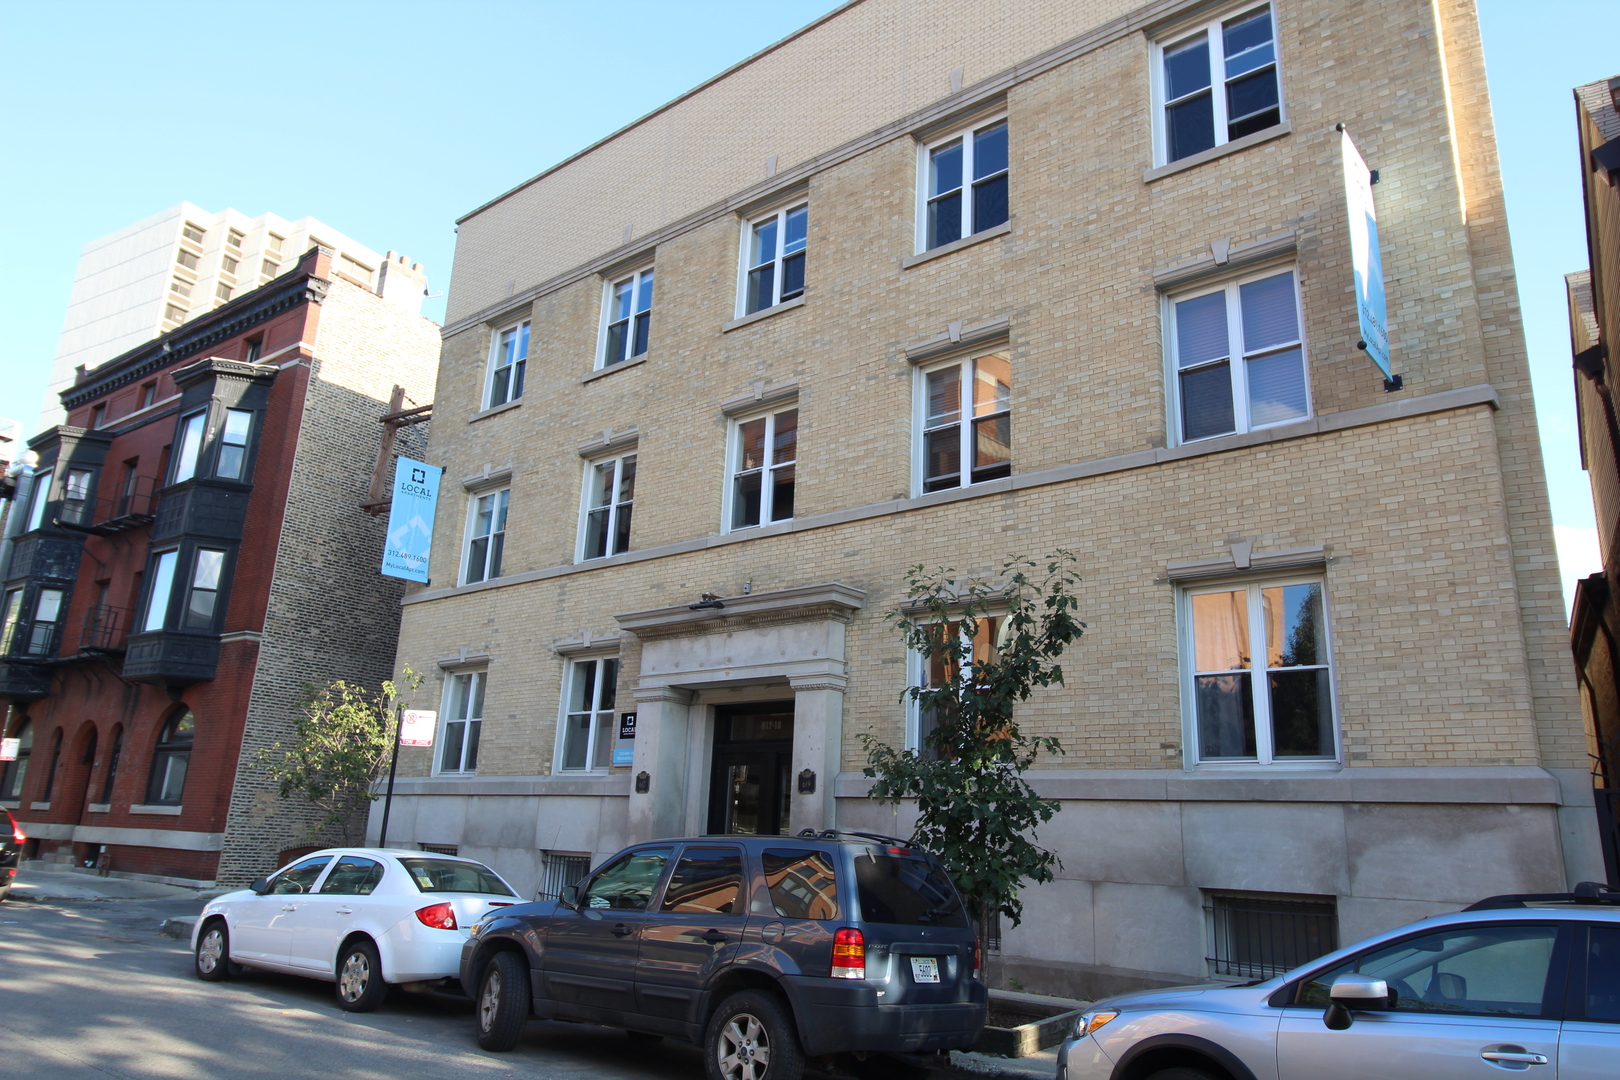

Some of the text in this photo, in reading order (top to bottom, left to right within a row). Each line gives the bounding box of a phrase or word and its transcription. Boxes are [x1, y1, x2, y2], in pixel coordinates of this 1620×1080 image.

[401, 482, 432, 497] LOCAL
[401, 490, 431, 502] APARTMENTS
[388, 549, 427, 564] 312.489.1600
[386, 562, 425, 574] MyLocalApt.com
[802, 780, 811, 788] 619
